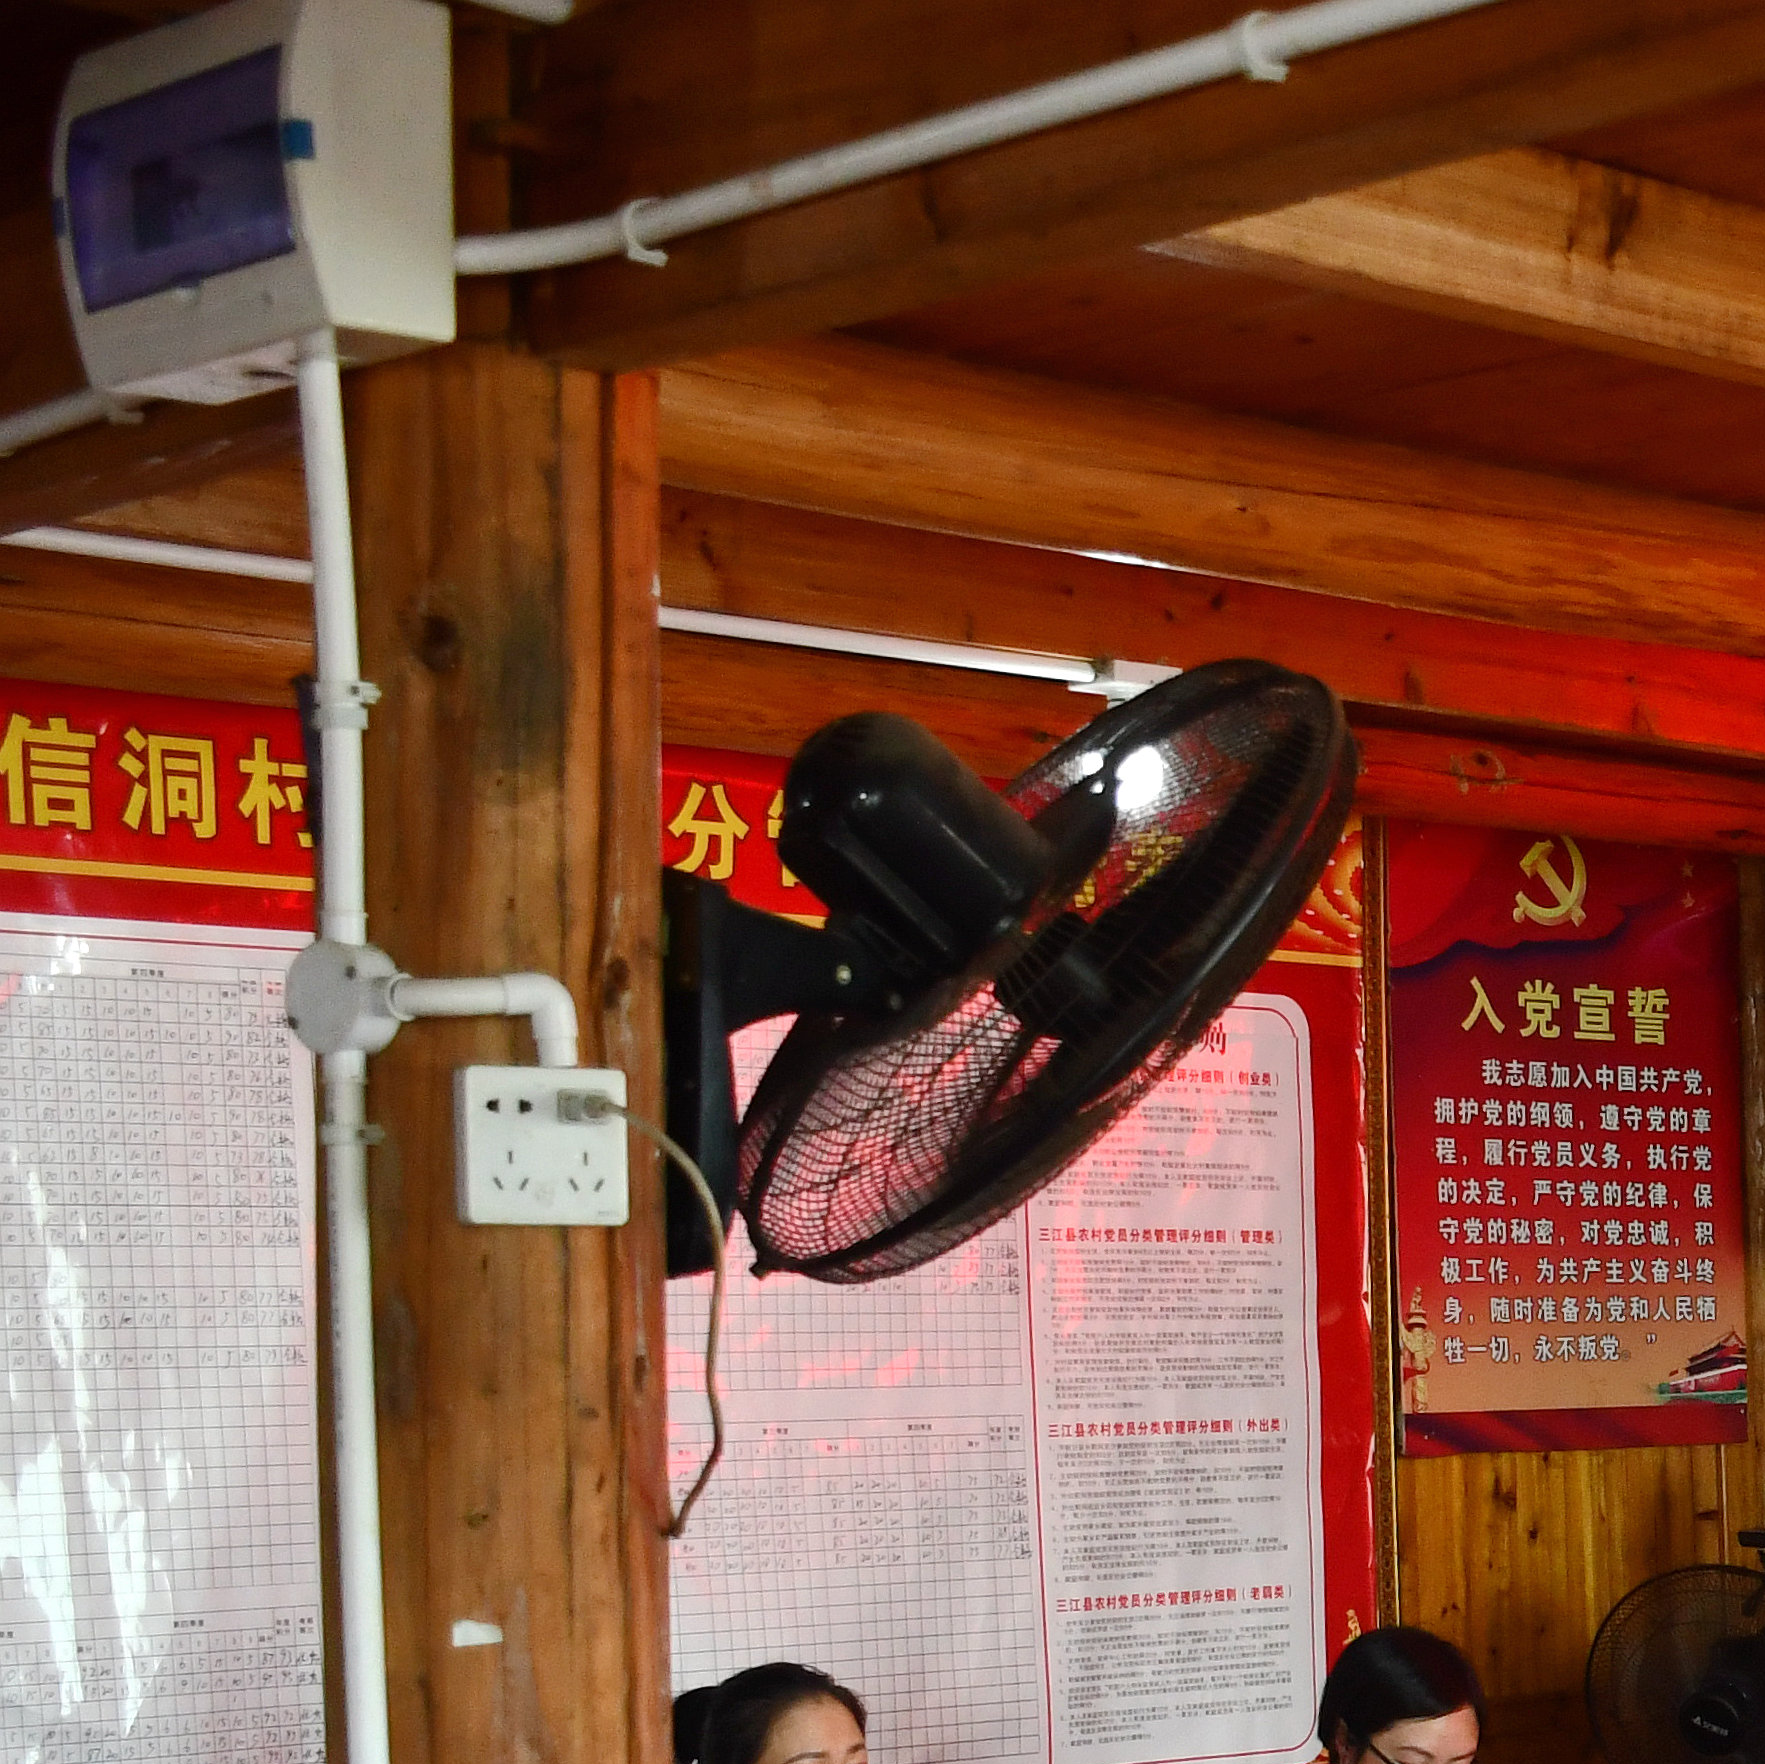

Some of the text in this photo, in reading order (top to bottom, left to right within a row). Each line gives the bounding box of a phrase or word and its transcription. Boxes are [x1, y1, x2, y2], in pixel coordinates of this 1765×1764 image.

[1461, 975, 1671, 1046] 入党宣誓
[1481, 1057, 1714, 1097] 我志愿加入中国共产党，
[1433, 1096, 1712, 1134] 拥护党的纲领，遵守党的章
[1435, 1136, 1713, 1172] 程，履行党员义务，执行党
[1437, 1176, 1714, 1210] 的决定，严守党的纪律，保
[1438, 1216, 1715, 1247] 守党的秘密，对党忠诚，积
[1440, 1255, 1716, 1286] 极工作，为共产主义奋斗终
[1443, 1295, 1717, 1325] 身，随时准备为党和人民牺
